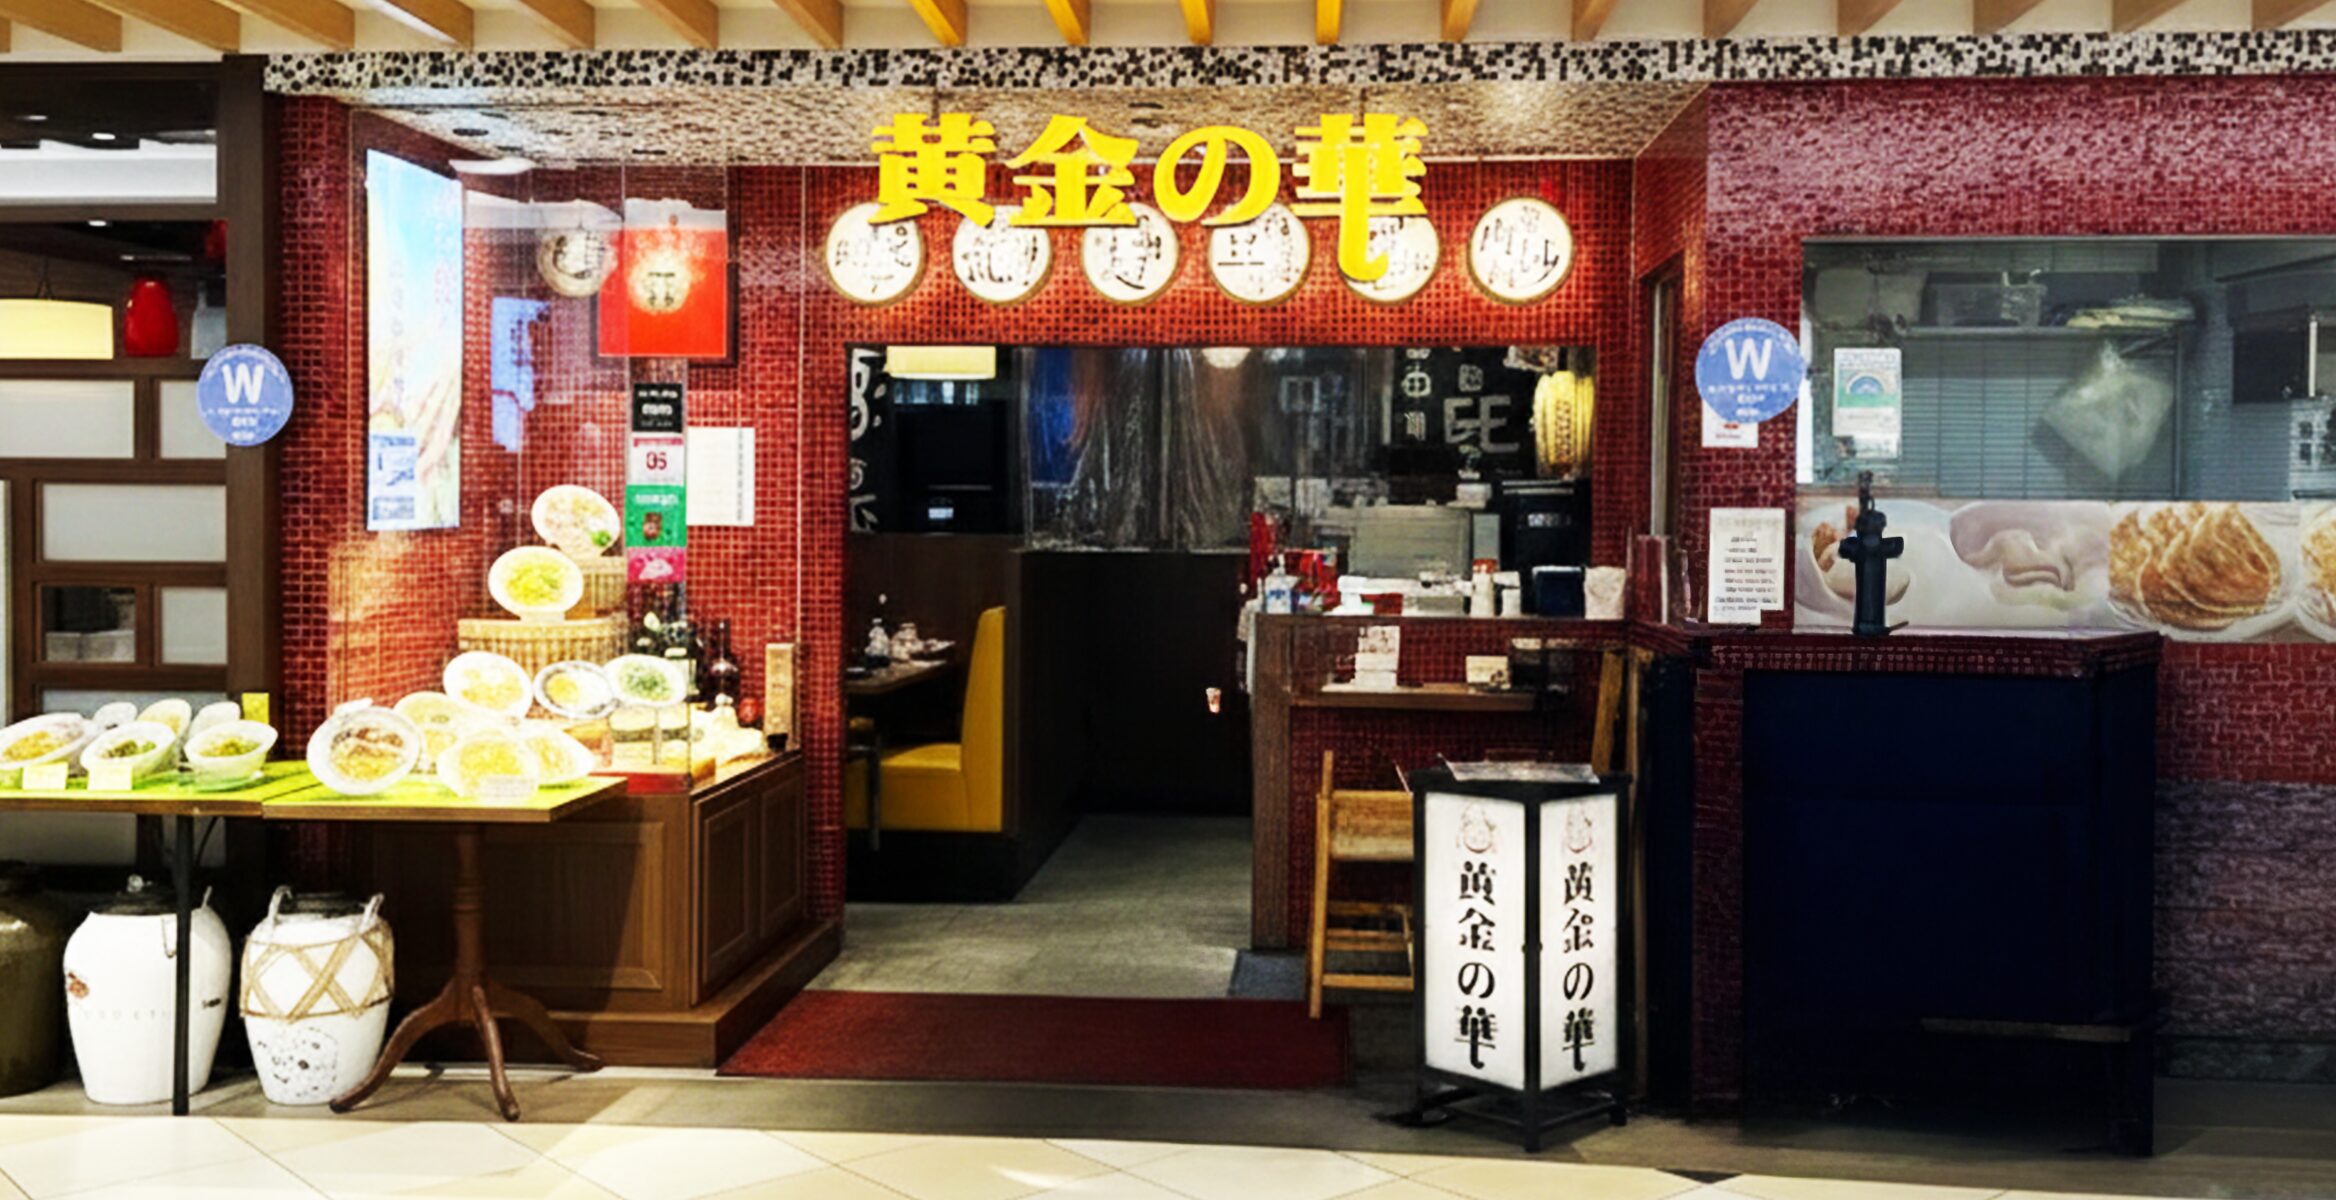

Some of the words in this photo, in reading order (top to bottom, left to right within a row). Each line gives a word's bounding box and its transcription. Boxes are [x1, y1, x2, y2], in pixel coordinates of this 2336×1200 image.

[868, 113, 1428, 282] 黄金の華
[222, 363, 265, 405] W
[1725, 338, 1772, 380] W
[1455, 861, 1497, 1069] 黄金の華
[1562, 861, 1596, 1072] 黄金の華
